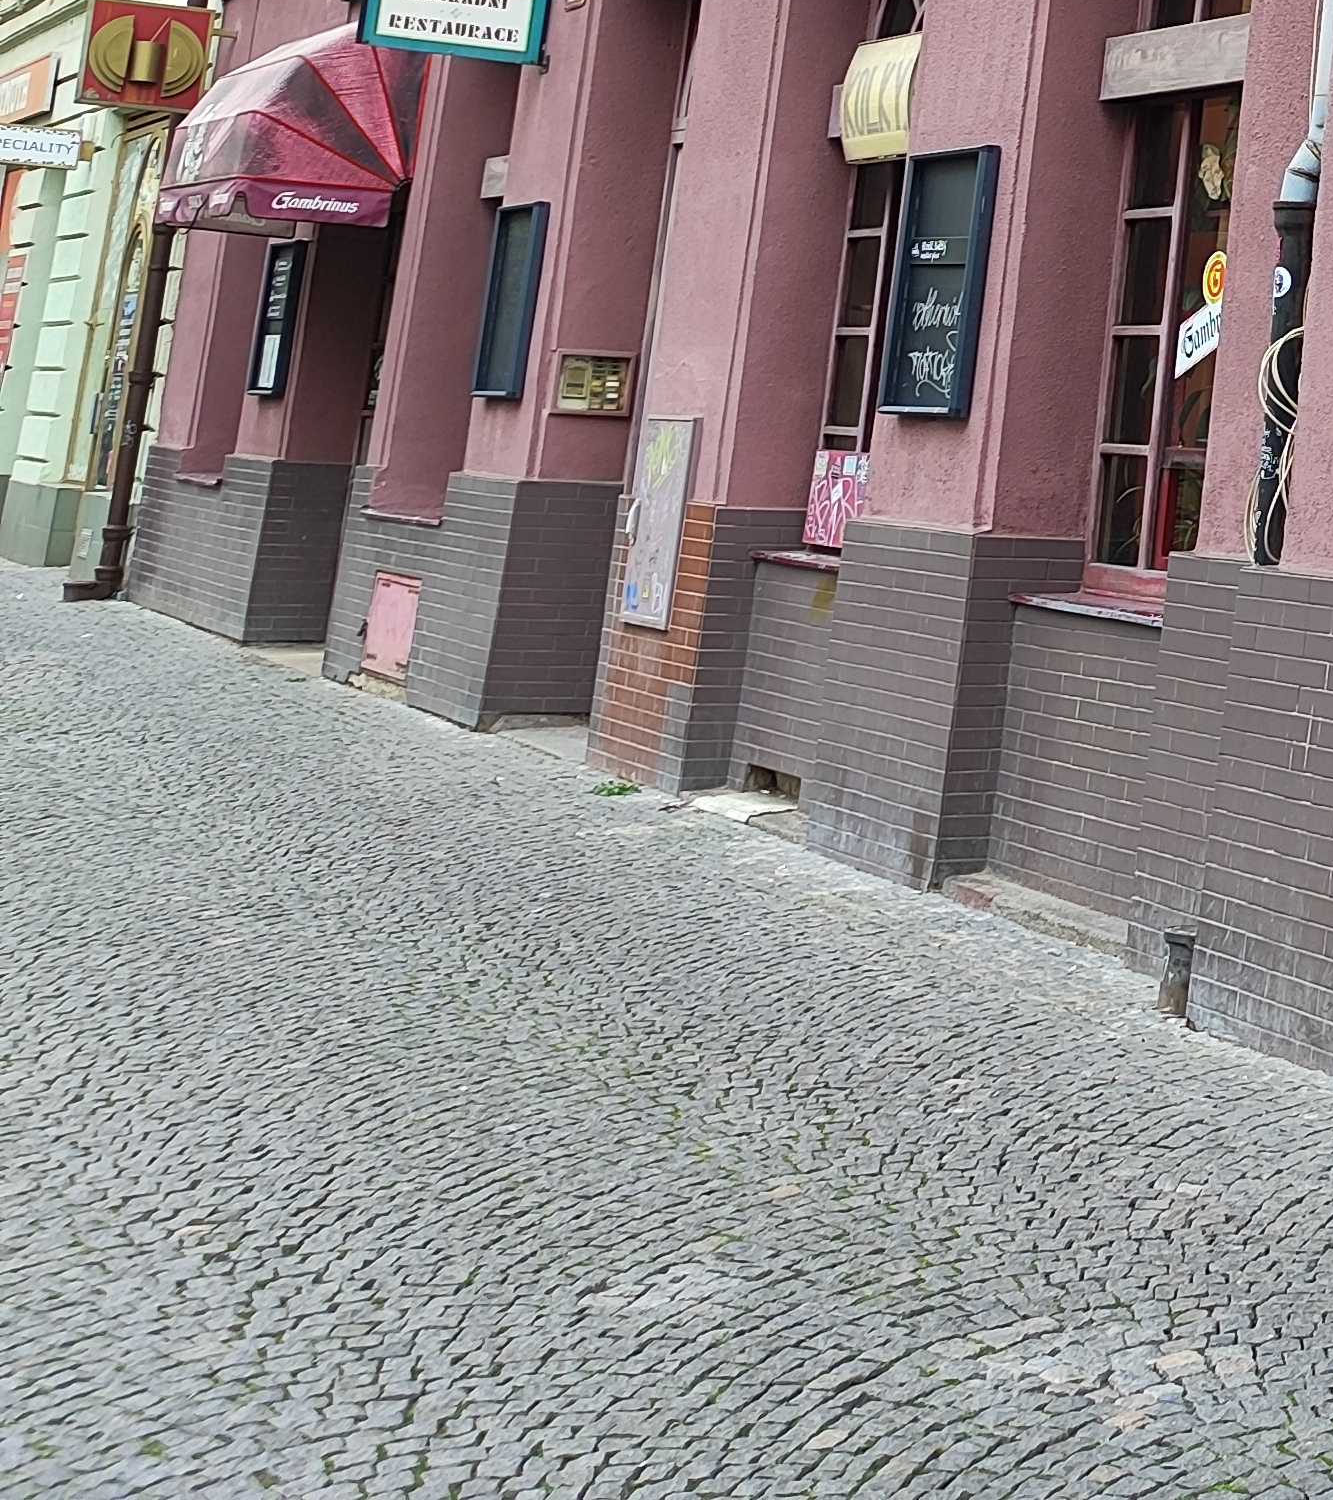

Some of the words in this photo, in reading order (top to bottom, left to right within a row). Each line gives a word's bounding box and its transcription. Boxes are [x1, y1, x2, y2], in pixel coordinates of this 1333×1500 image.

[388, 13, 519, 43] RESTAURACE
[0, 137, 74, 155] ECIALITY
[271, 191, 360, 214] Gambrinus
